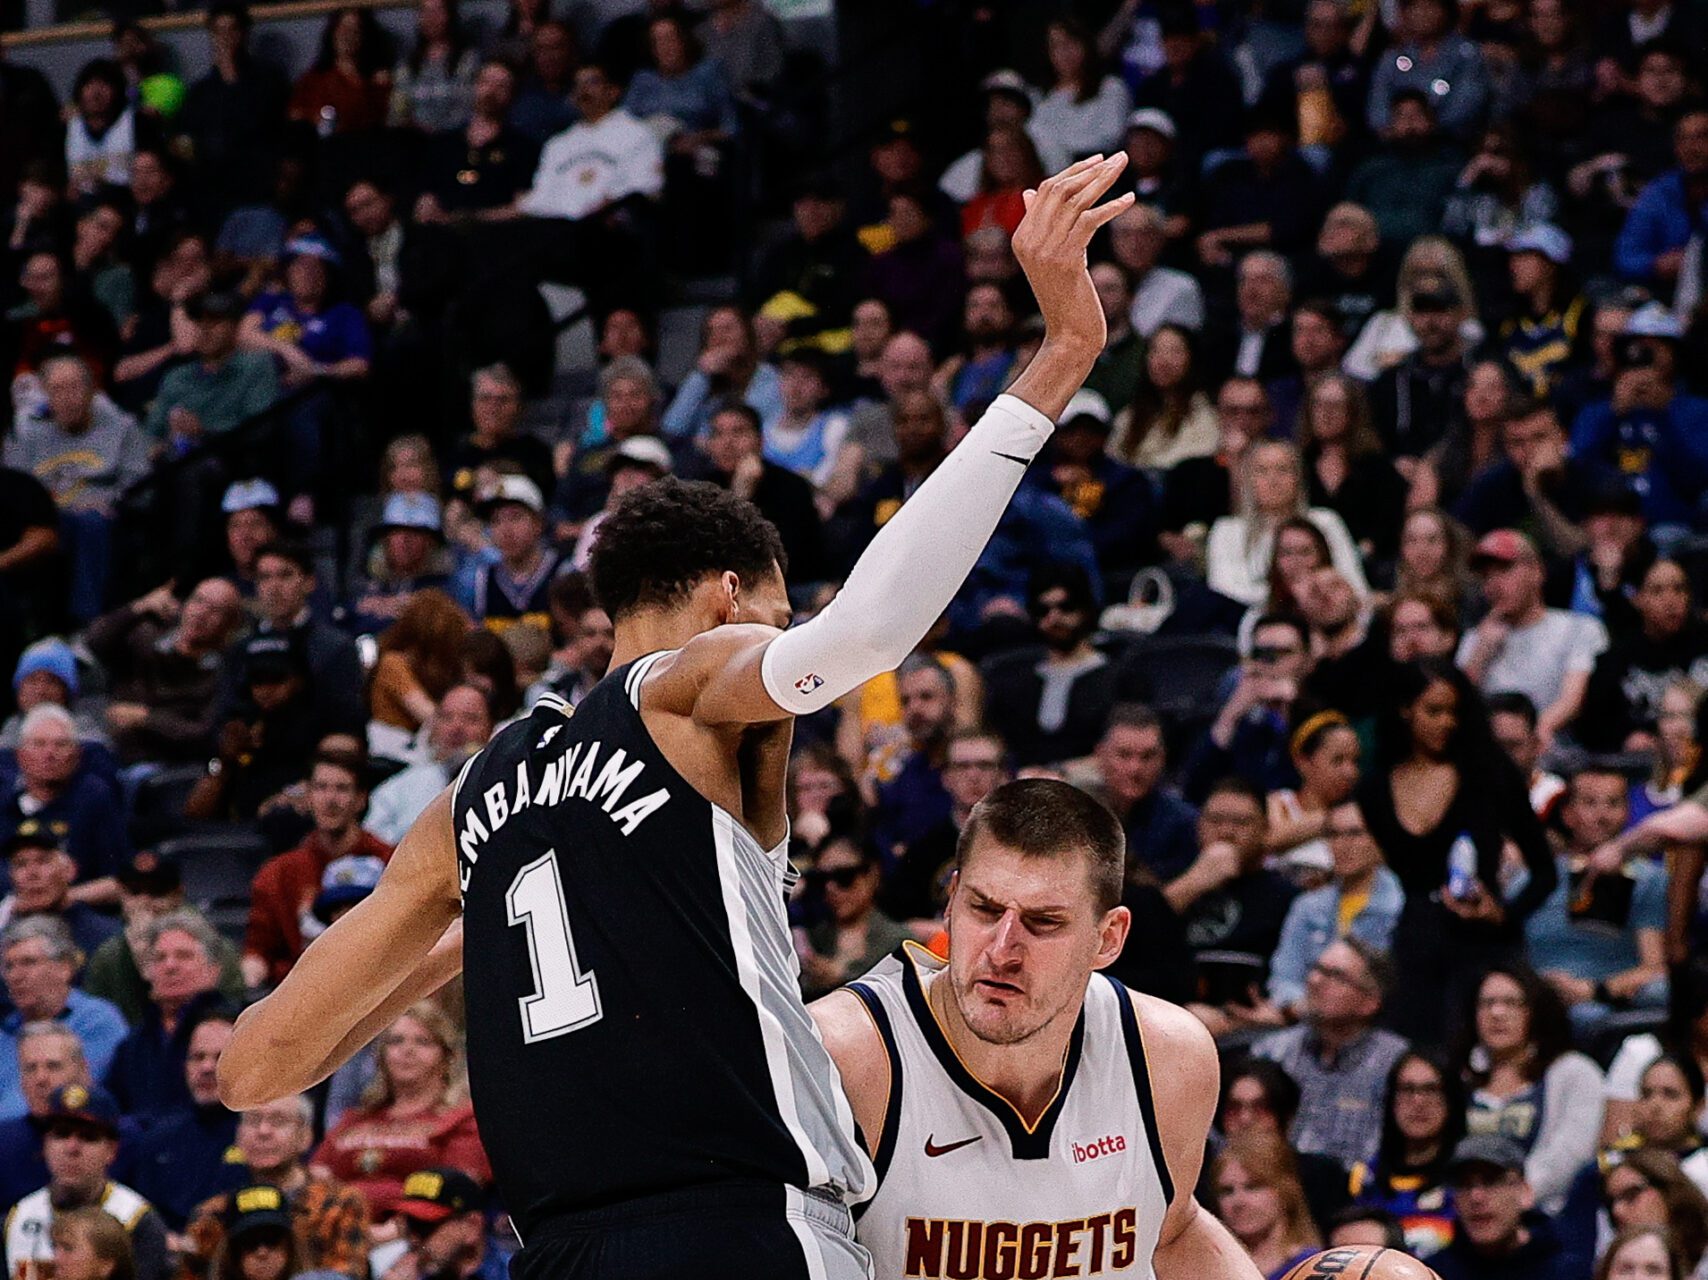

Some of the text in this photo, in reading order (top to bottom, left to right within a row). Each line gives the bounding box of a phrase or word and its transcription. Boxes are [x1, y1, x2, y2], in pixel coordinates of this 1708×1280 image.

[460, 741, 671, 910] EMBANYAMA
[505, 848, 603, 1044] 1
[1071, 1135, 1126, 1164] ibotta
